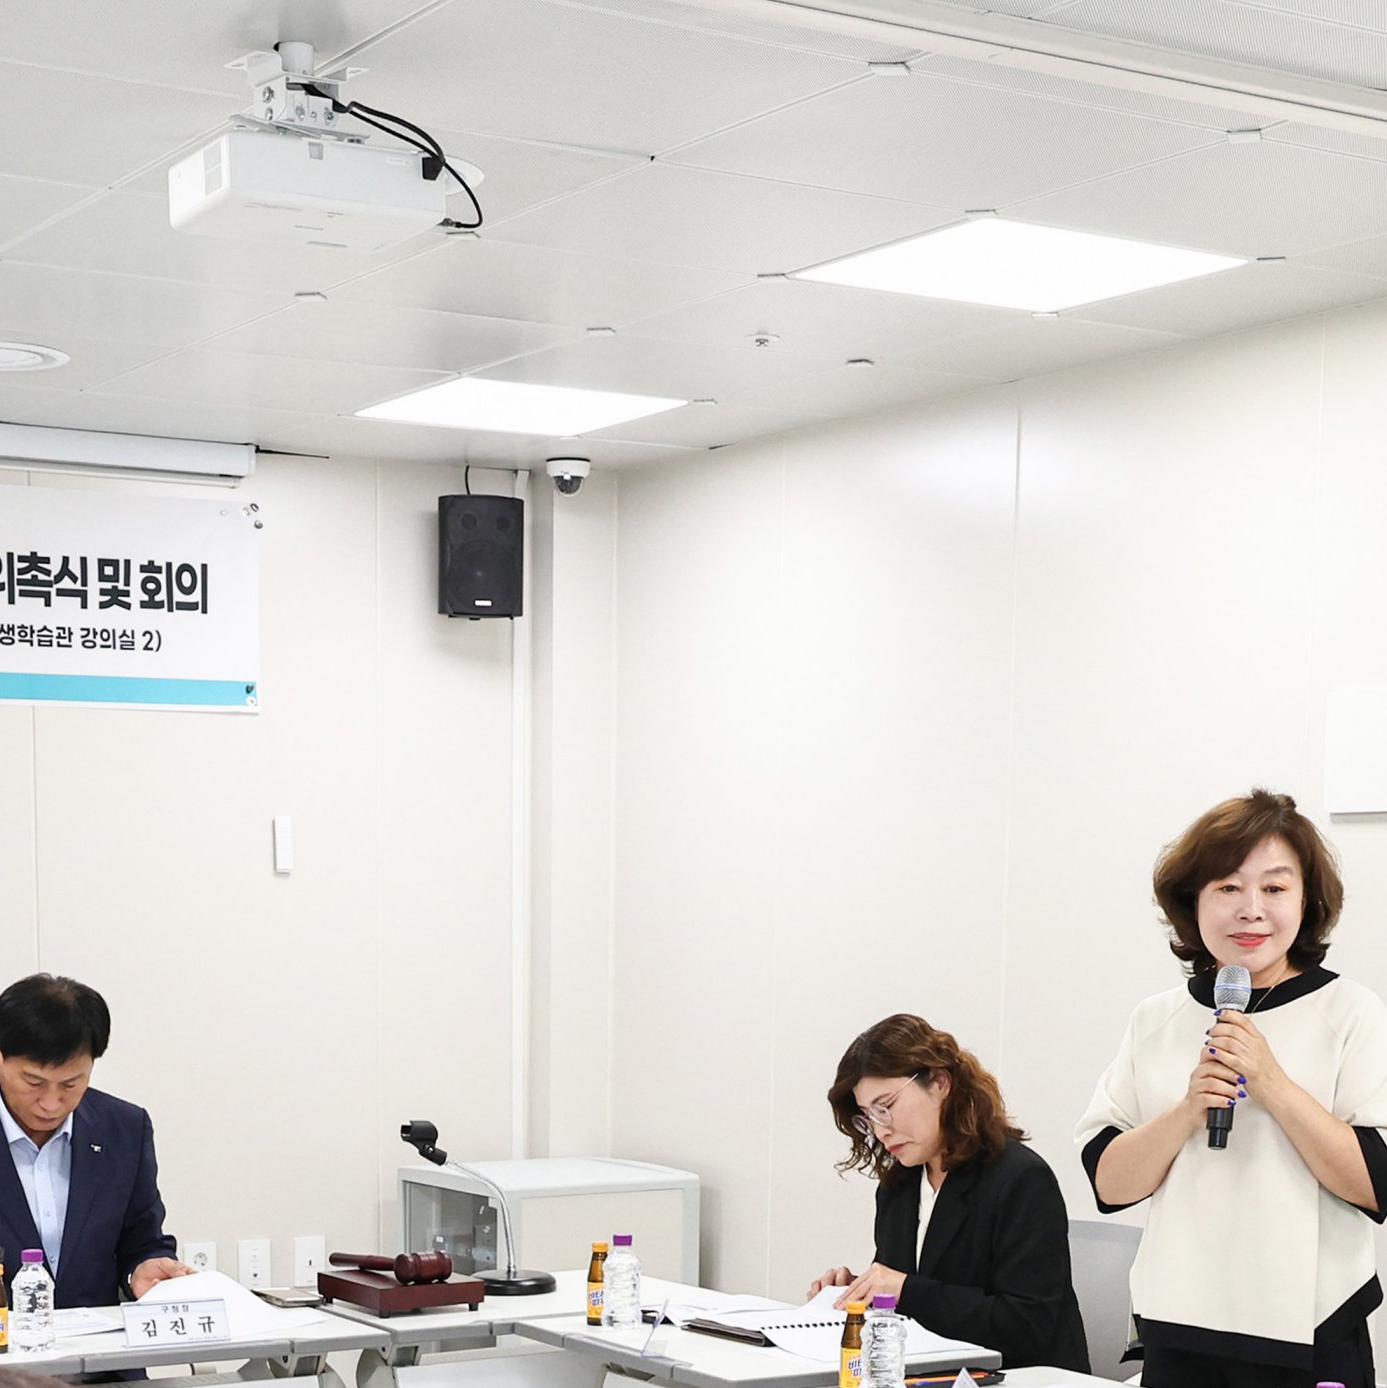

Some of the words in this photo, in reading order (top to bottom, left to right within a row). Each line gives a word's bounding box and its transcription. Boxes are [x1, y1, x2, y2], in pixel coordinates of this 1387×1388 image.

[97, 557, 132, 611] 및
[139, 559, 208, 615] 회의
[79, 627, 135, 651] 강의실
[142, 629, 162, 653] 2)
